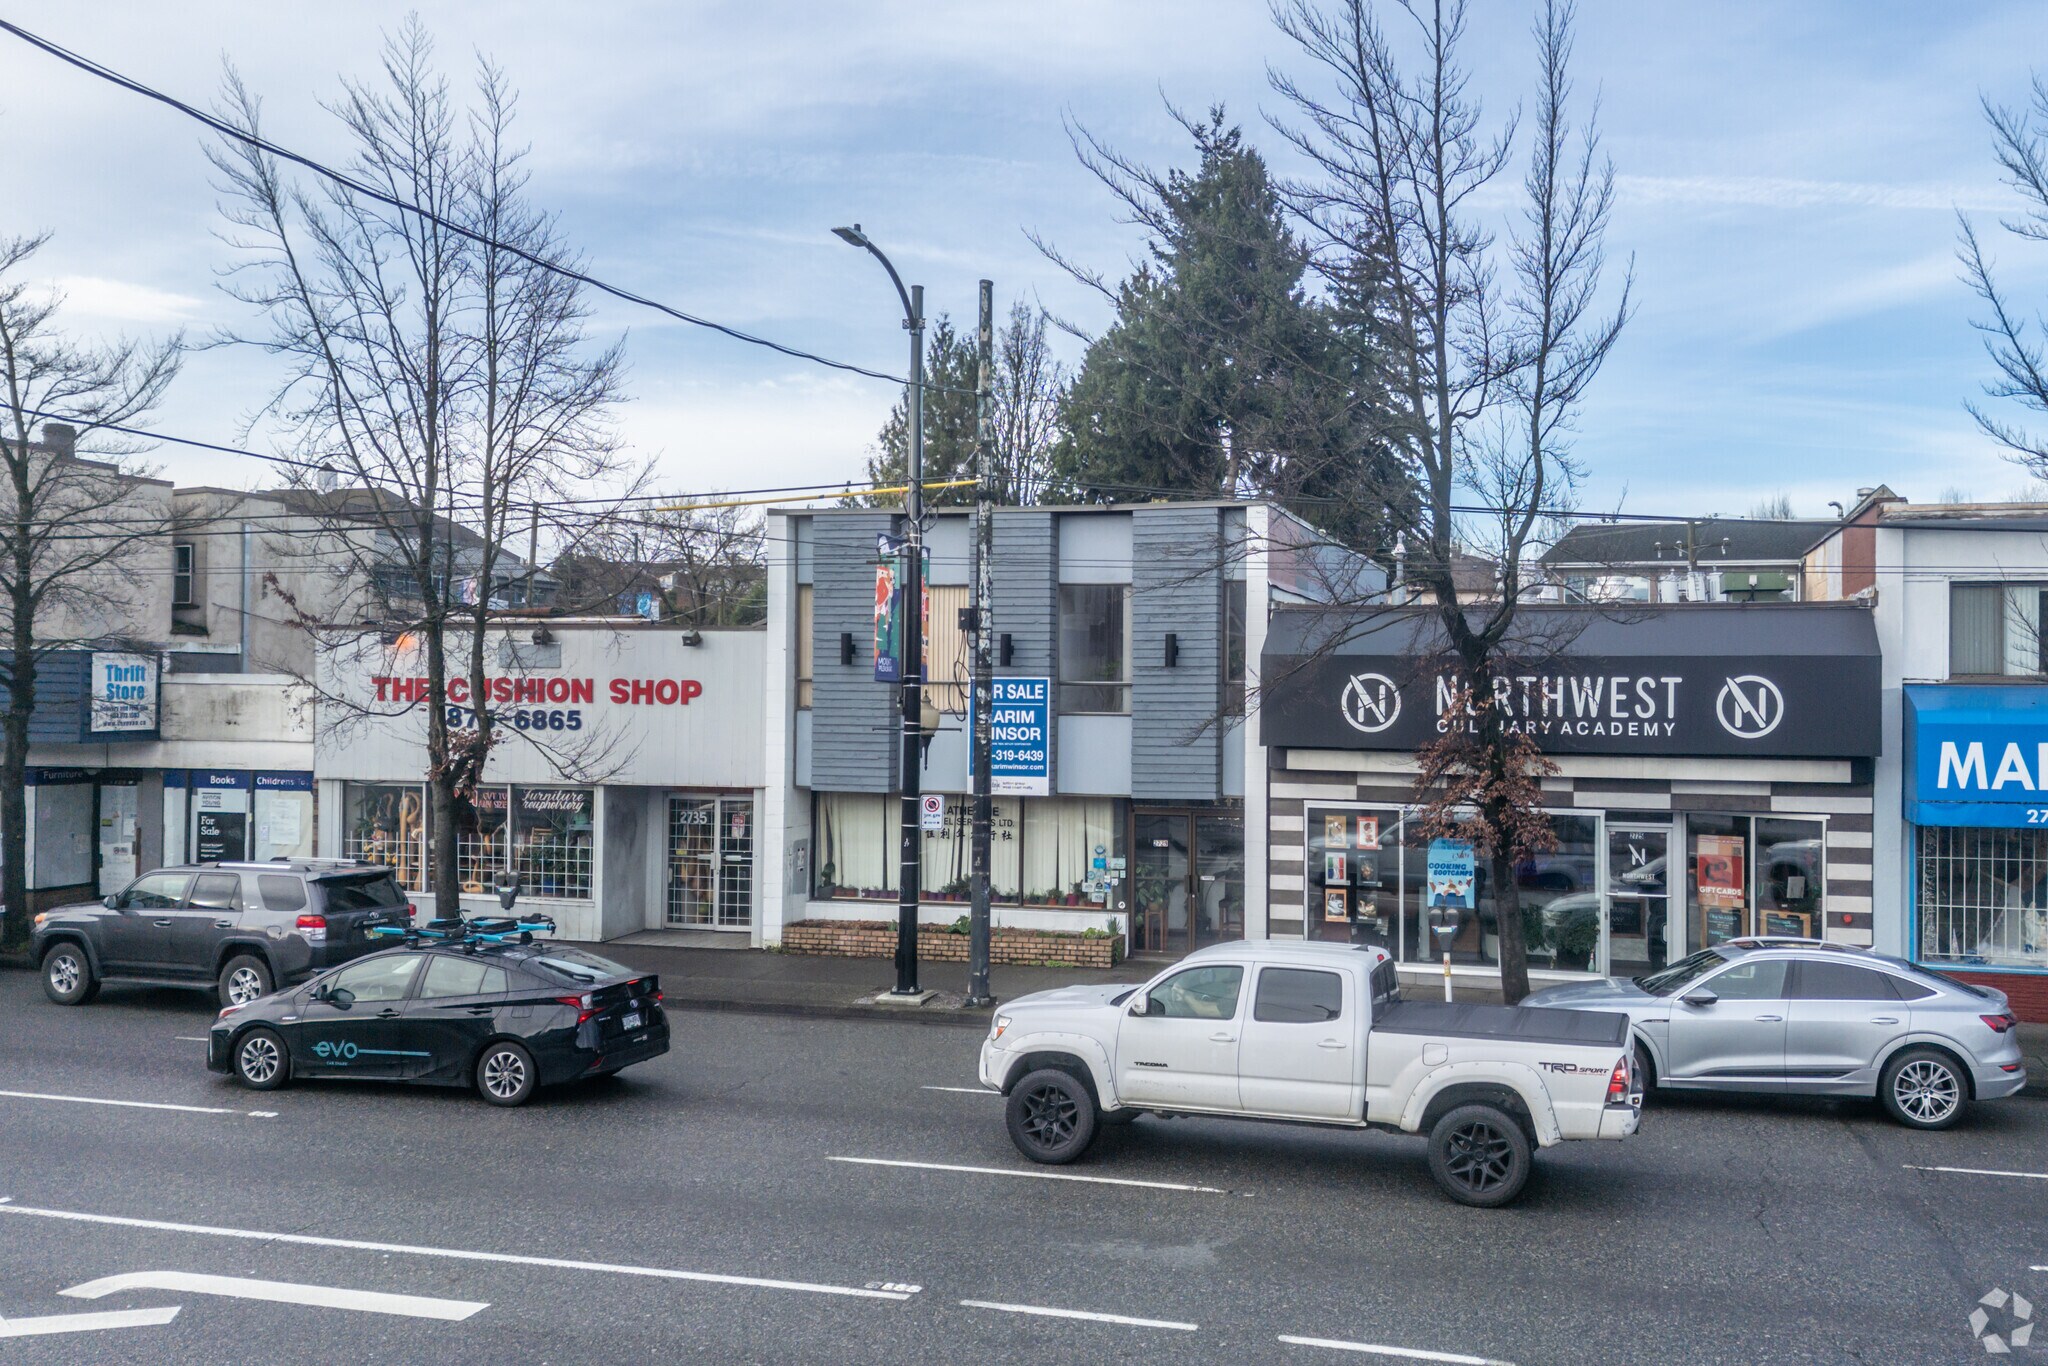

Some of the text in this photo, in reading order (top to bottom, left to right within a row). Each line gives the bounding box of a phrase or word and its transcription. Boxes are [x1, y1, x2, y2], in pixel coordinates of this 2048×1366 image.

[105, 664, 146, 682] Thrift
[106, 682, 145, 701] Store
[609, 678, 703, 705] SHOP
[1006, 684, 1044, 700] SALE
[993, 710, 1035, 724] ARIM
[991, 727, 1041, 741] INSOR
[1560, 721, 1676, 737] ACADEMY
[43, 770, 83, 780] Furniture
[210, 775, 236, 785] Books
[256, 776, 295, 786] Childrens
[521, 788, 585, 801] Furniture
[200, 815, 215, 825] For
[680, 811, 708, 824] 2735
[998, 819, 1015, 828] LTD.
[200, 826, 220, 836] Sale
[1428, 862, 1467, 870] COOKING
[1433, 869, 1474, 877] BOOTCAMPS
[1622, 872, 1656, 880] NORTHWEST
[1699, 886, 1742, 896] GIFT CARDS
[316, 1039, 358, 1059] evo
[1538, 1061, 1610, 1074] TRD SPORT
